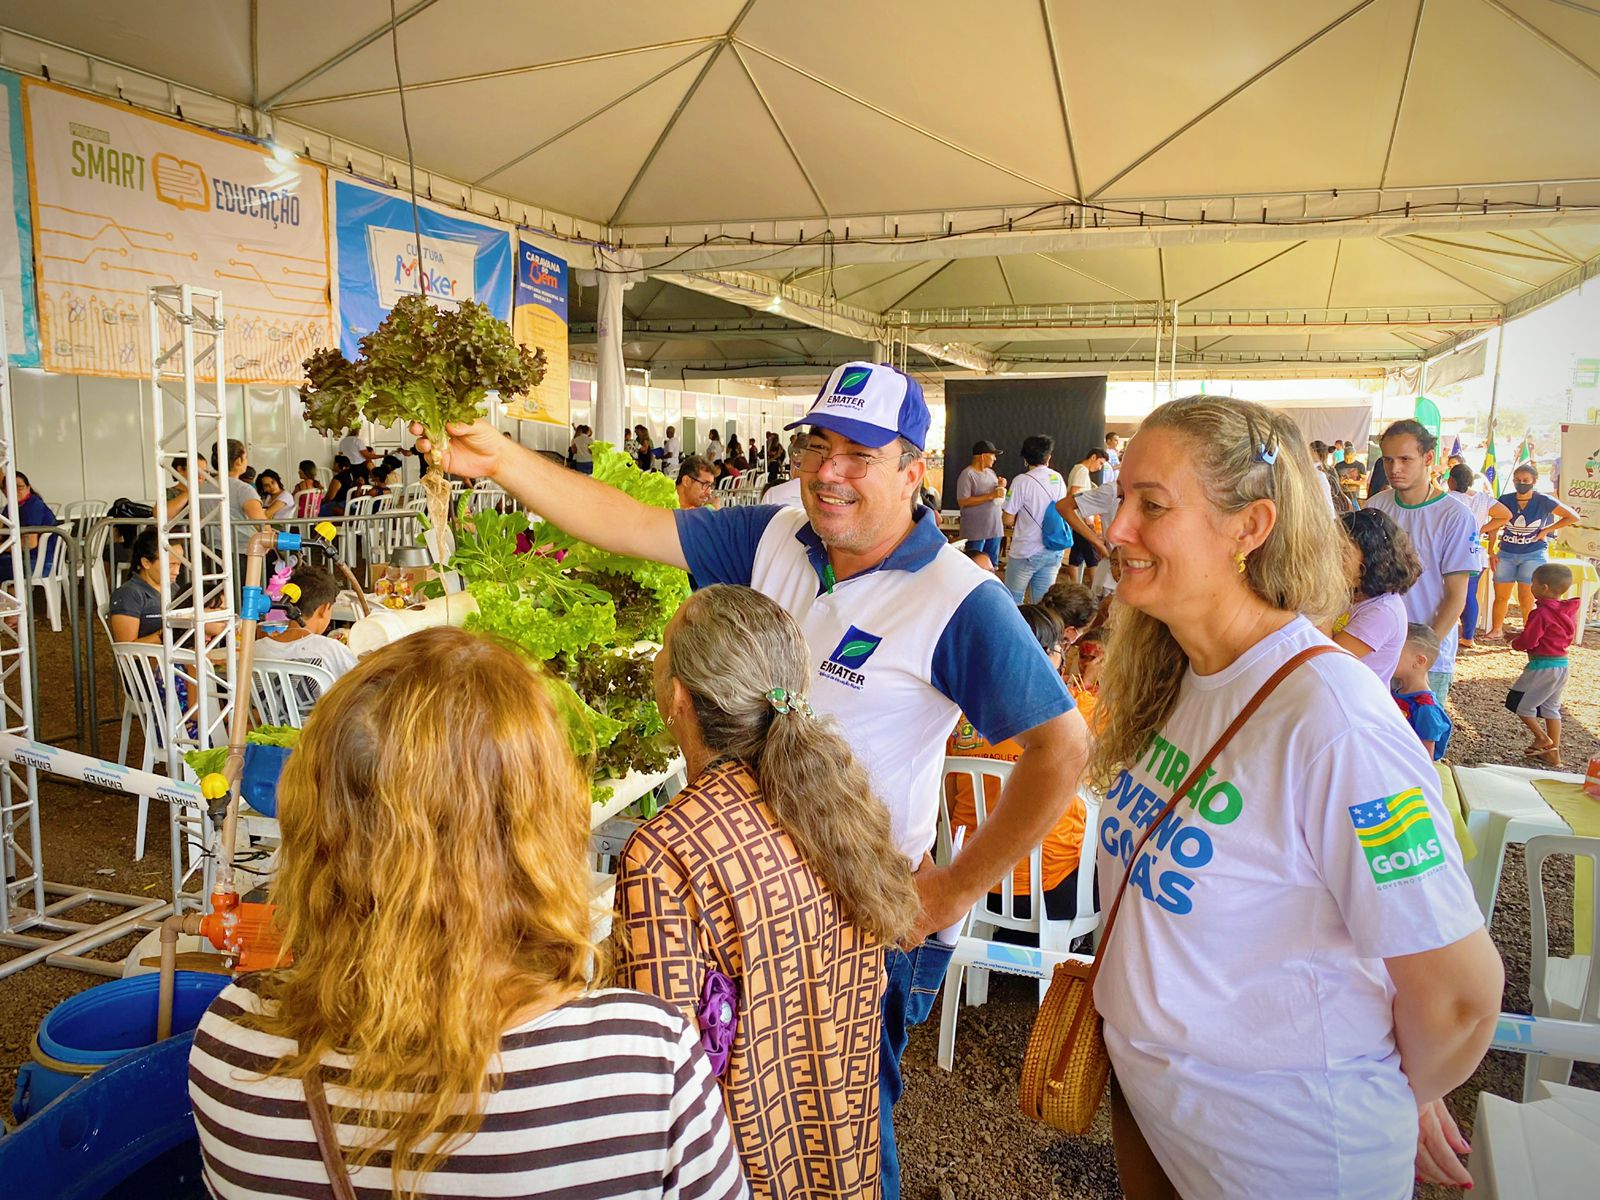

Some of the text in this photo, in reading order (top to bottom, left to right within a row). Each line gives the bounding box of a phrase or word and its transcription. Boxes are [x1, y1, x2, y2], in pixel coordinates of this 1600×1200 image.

[72, 140, 144, 191] SMART
[212, 178, 299, 229] EDUCAÇÃO
[406, 243, 444, 264] CUTURA
[526, 251, 560, 273] CARAVANA
[394, 254, 457, 296] Maker
[827, 395, 865, 408] EMATER
[819, 660, 865, 686] EMATER
[1136, 731, 1243, 825] TIRÃO
[1106, 768, 1213, 868] OVERNO
[1101, 816, 1195, 915] GOÁS
[1372, 839, 1440, 874] GOIÁS
